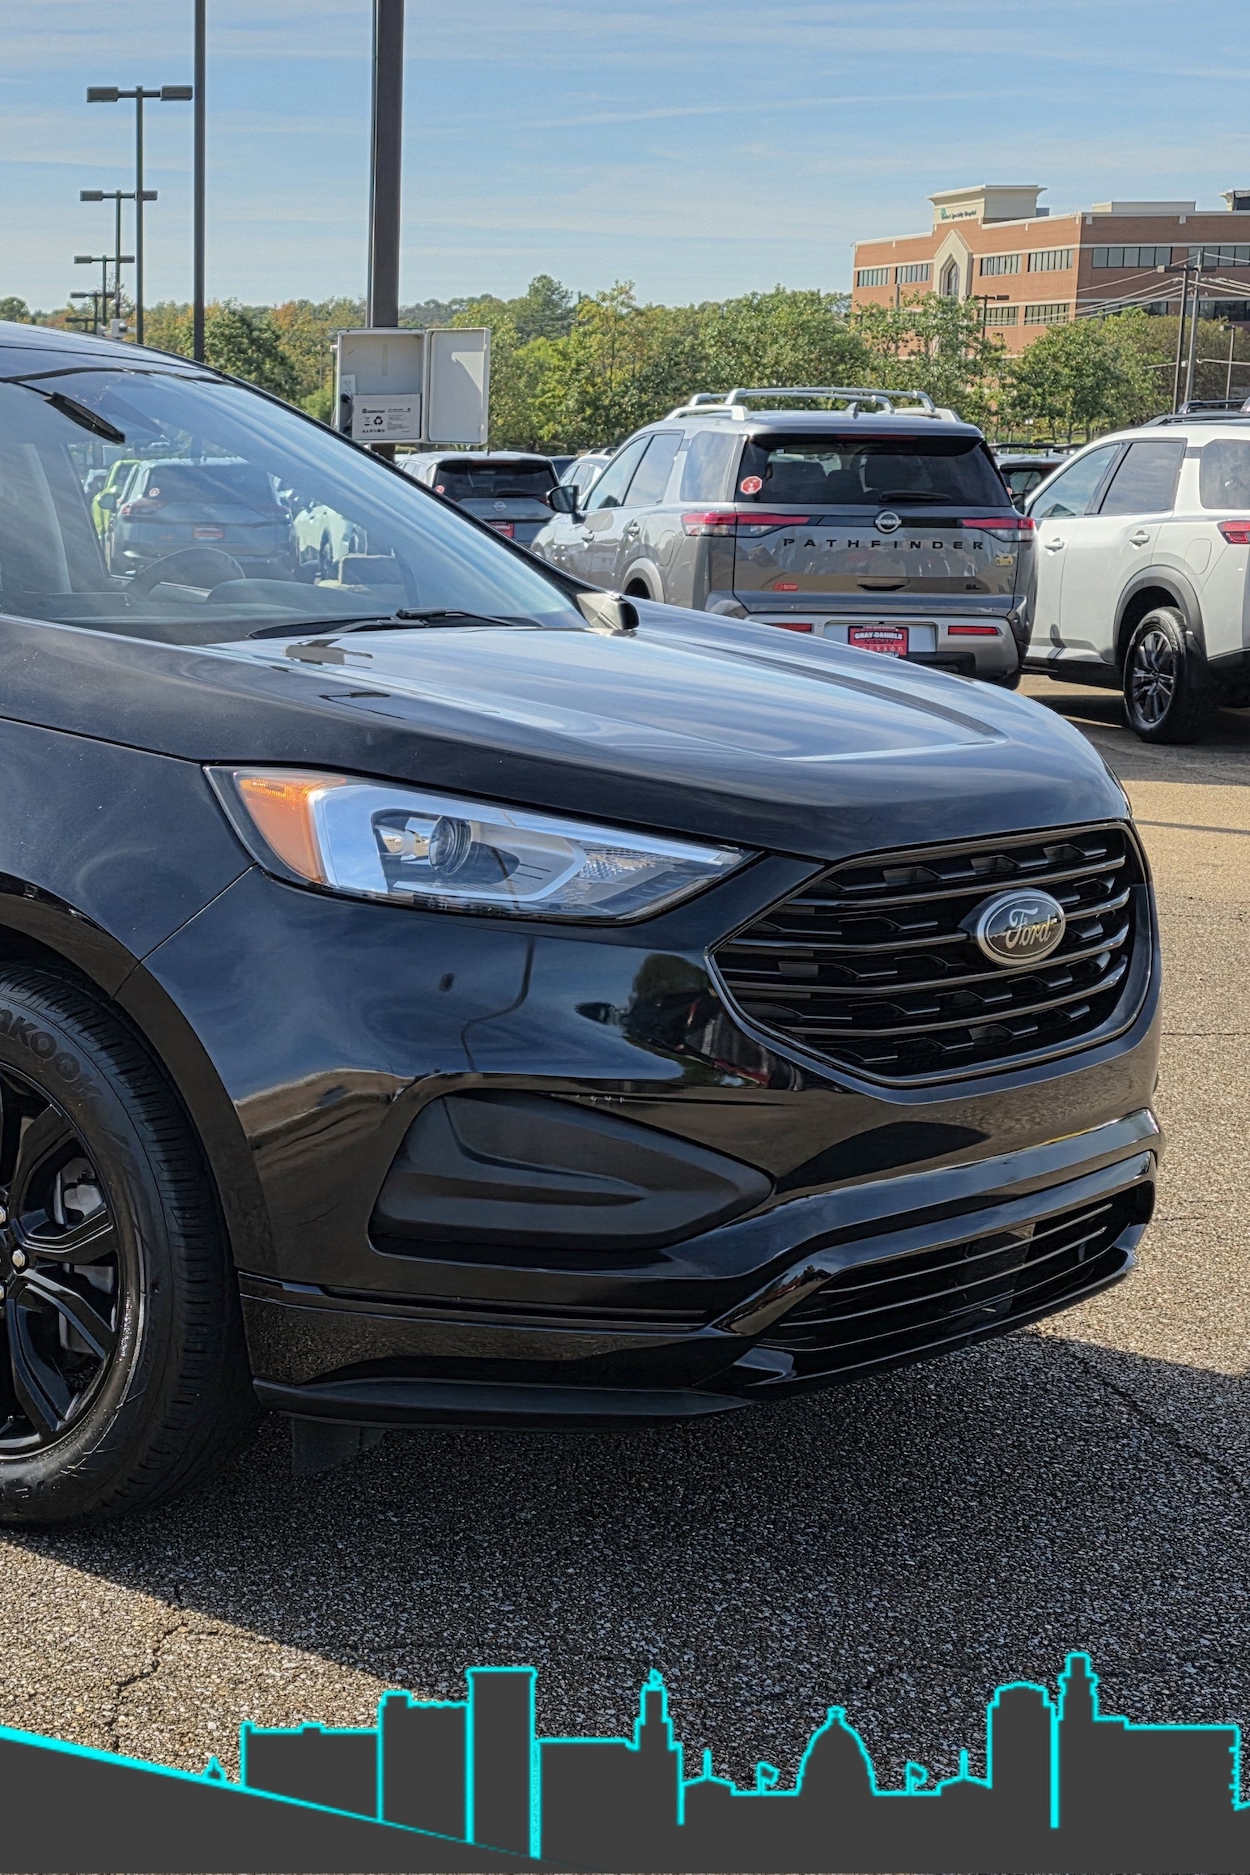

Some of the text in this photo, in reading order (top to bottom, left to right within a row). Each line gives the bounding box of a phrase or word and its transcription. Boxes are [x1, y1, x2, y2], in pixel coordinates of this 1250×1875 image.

[783, 538, 984, 550] PATHFINDER
[854, 631, 903, 640] GRAY-DANIELS
[1005, 907, 1052, 949] Ford
